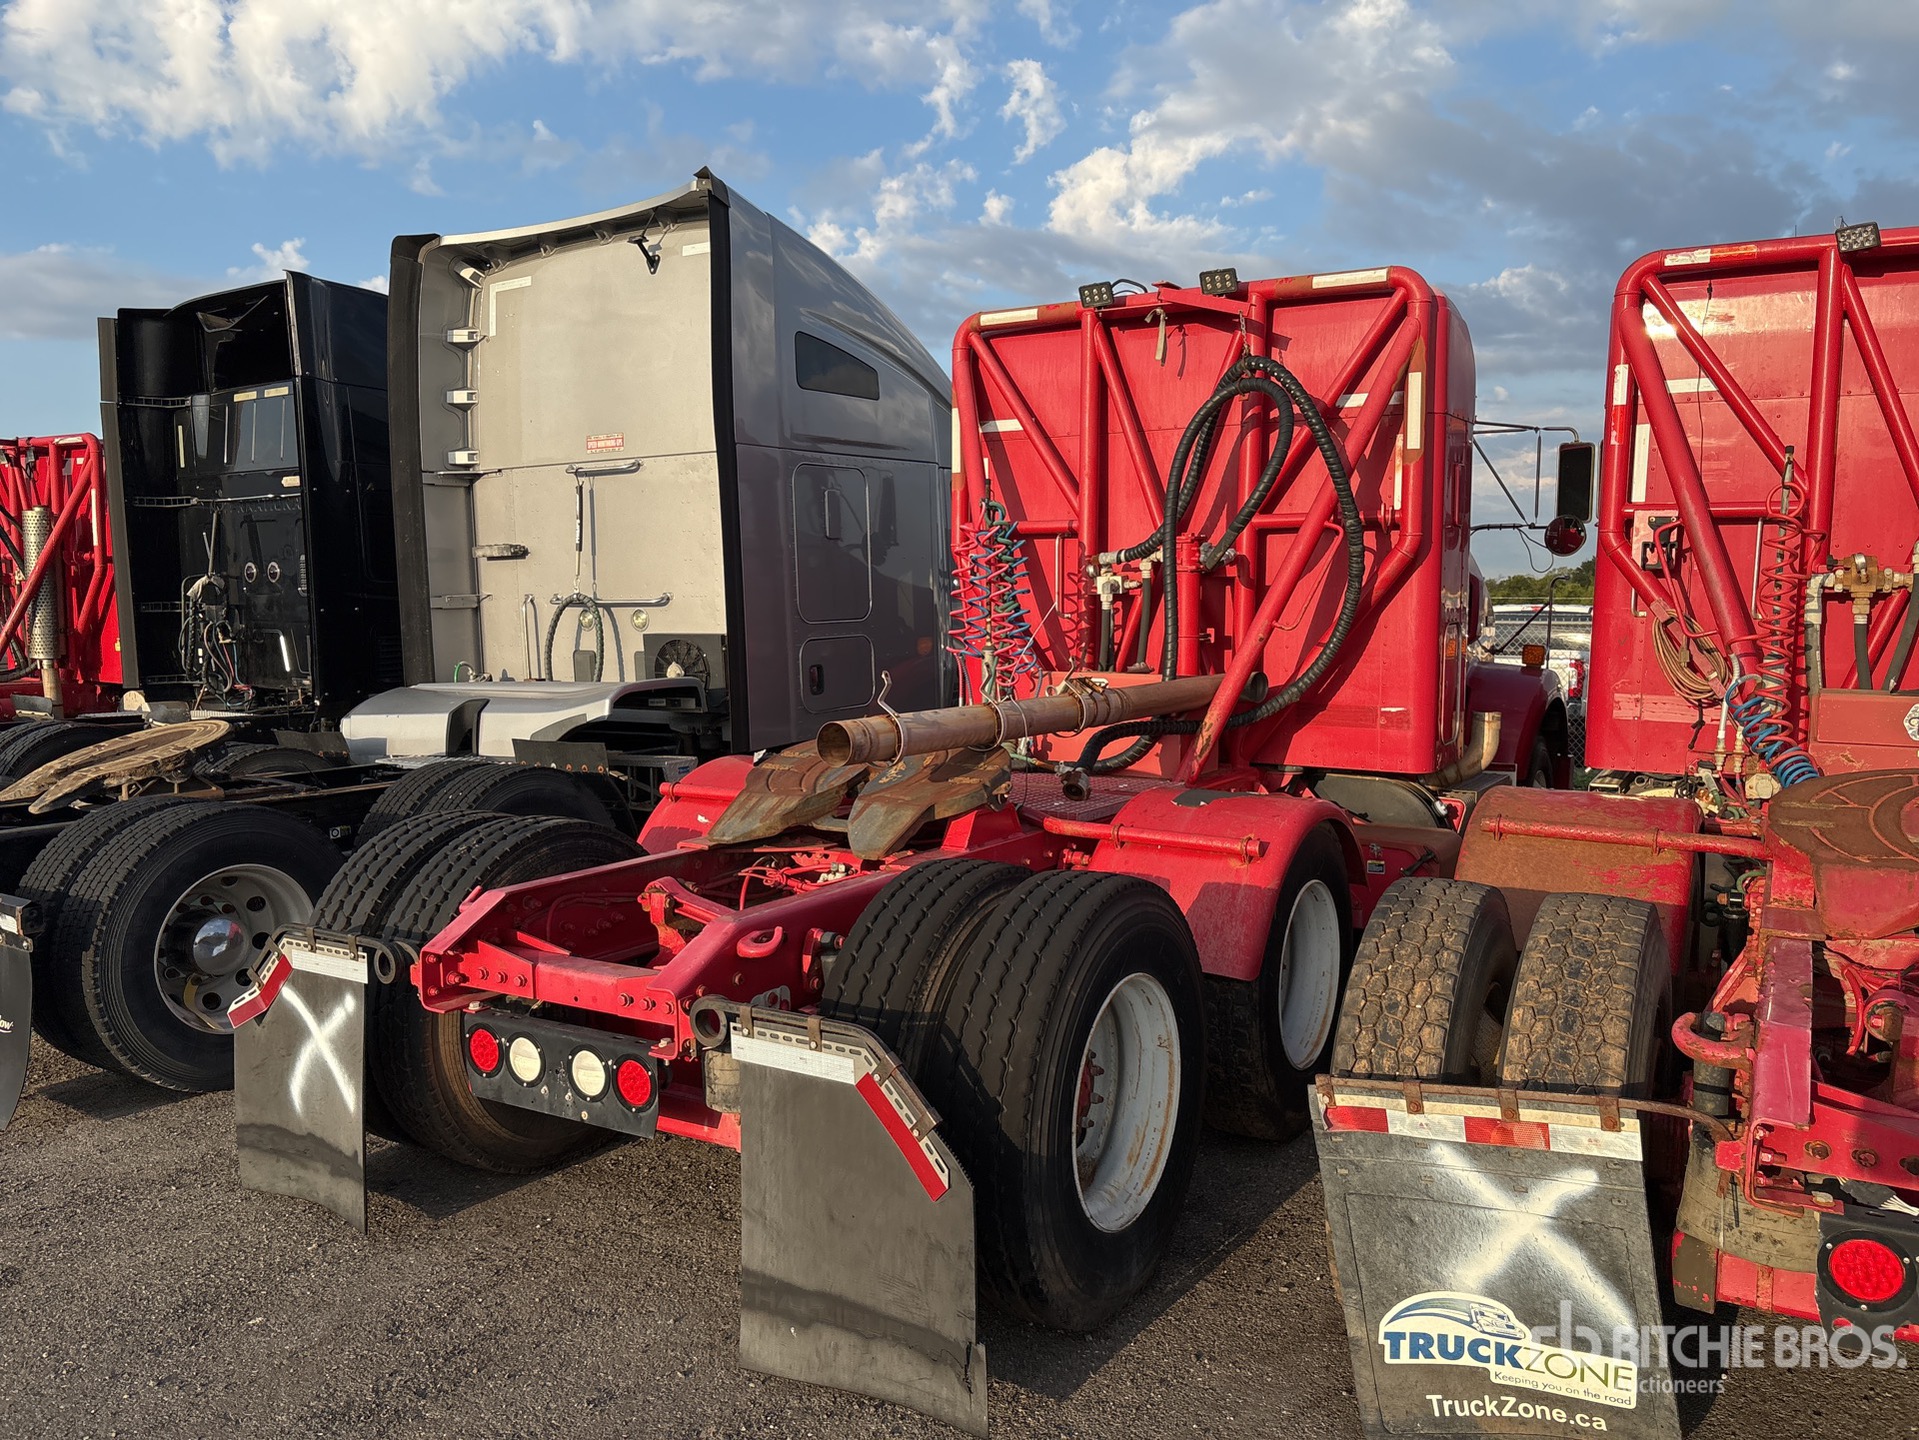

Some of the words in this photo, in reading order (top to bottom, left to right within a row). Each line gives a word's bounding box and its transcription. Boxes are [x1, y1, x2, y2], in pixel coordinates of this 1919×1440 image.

[1494, 1371, 1539, 1388] Keeping
[1542, 1381, 1562, 1391] you
[1565, 1387, 1580, 1395] on
[1583, 1388, 1601, 1400] the
[1604, 1389, 1632, 1406] road
[1425, 1394, 1608, 1432] TruckZone.ca
